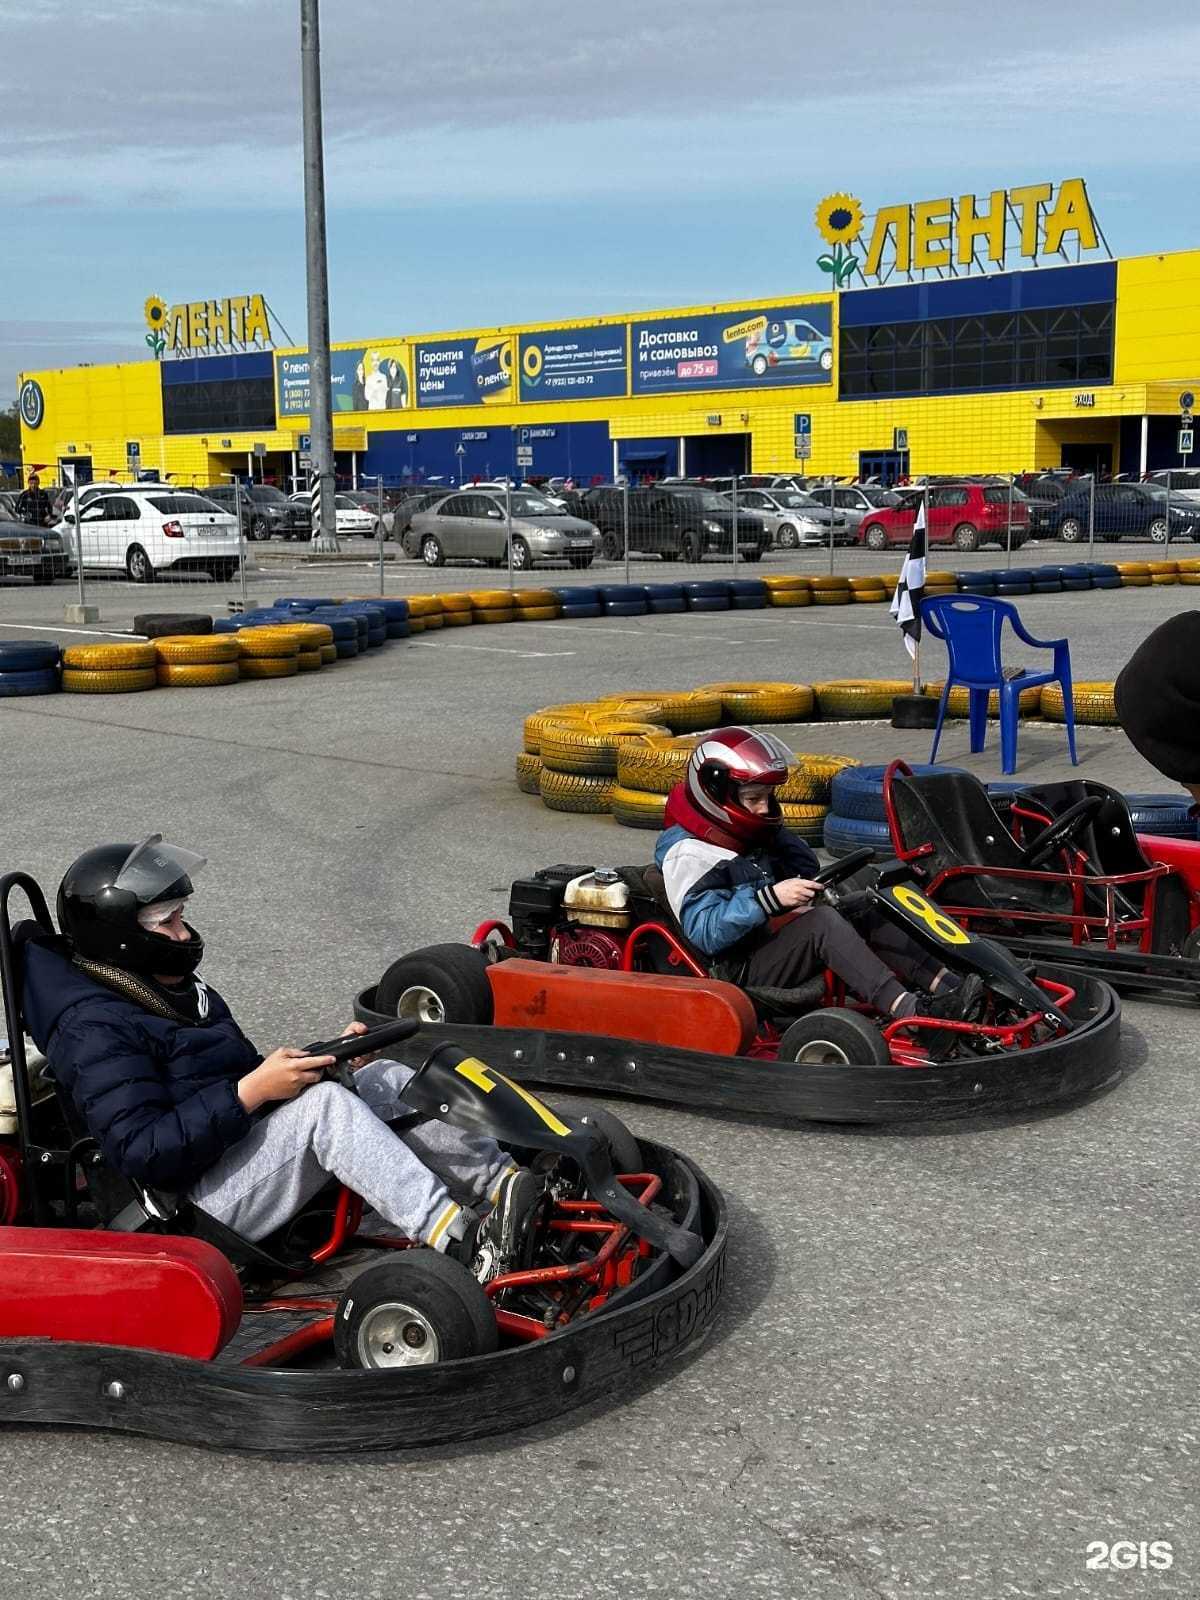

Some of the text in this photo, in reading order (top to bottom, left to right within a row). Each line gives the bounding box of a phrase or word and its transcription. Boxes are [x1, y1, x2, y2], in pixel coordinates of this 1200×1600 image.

[863, 178, 1099, 276] ЛЕНТА
[167, 294, 271, 351] ЛЕНТА
[639, 330, 698, 349] Доставка
[419, 350, 464, 366] Гарантия
[639, 345, 719, 362] и самовывоз
[419, 362, 457, 380] лучшей
[639, 367, 676, 381] привезём
[680, 367, 692, 377] до
[692, 363, 704, 374] 75
[419, 380, 445, 392] цены
[893, 886, 970, 944] 8
